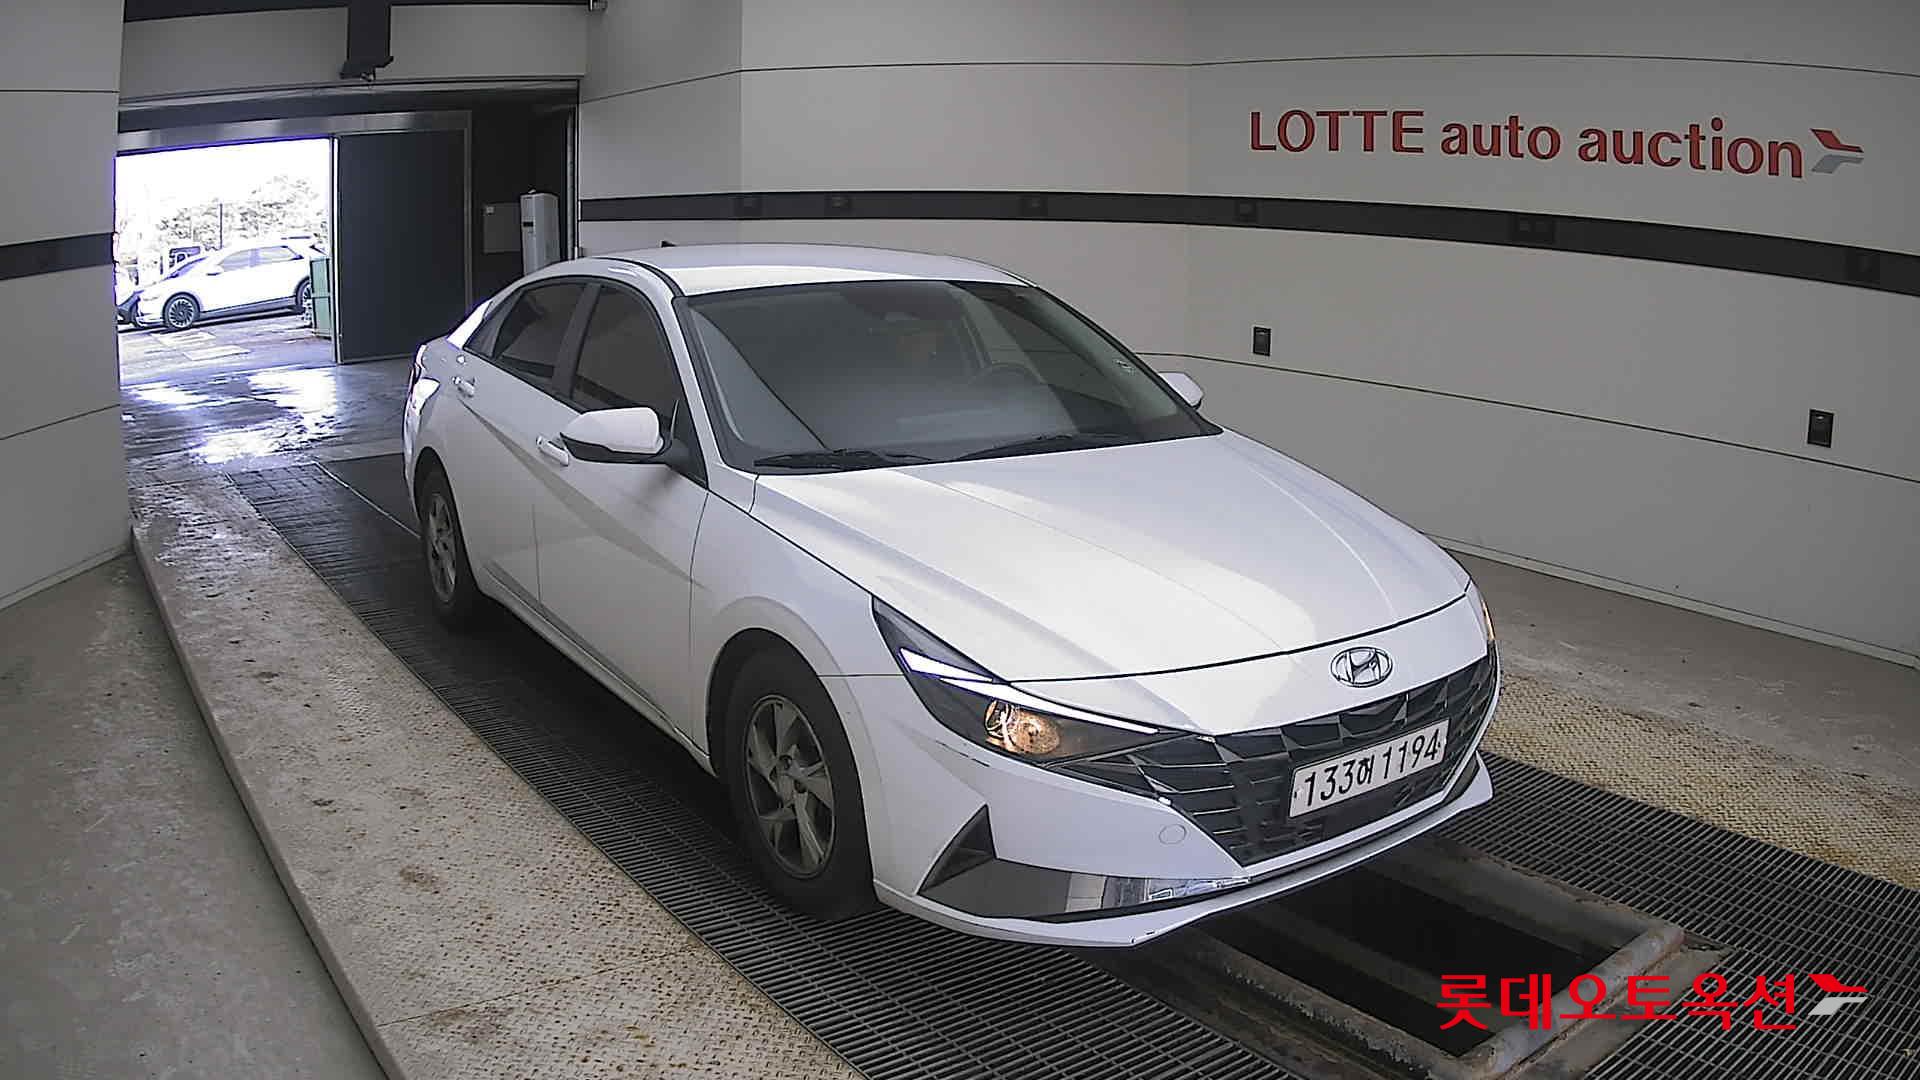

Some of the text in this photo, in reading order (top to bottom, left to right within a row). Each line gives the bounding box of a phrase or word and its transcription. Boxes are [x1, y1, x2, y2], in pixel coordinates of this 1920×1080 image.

[1250, 110, 1803, 178] LOTTE auto auction
[1304, 729, 1440, 806] 133허 1194
